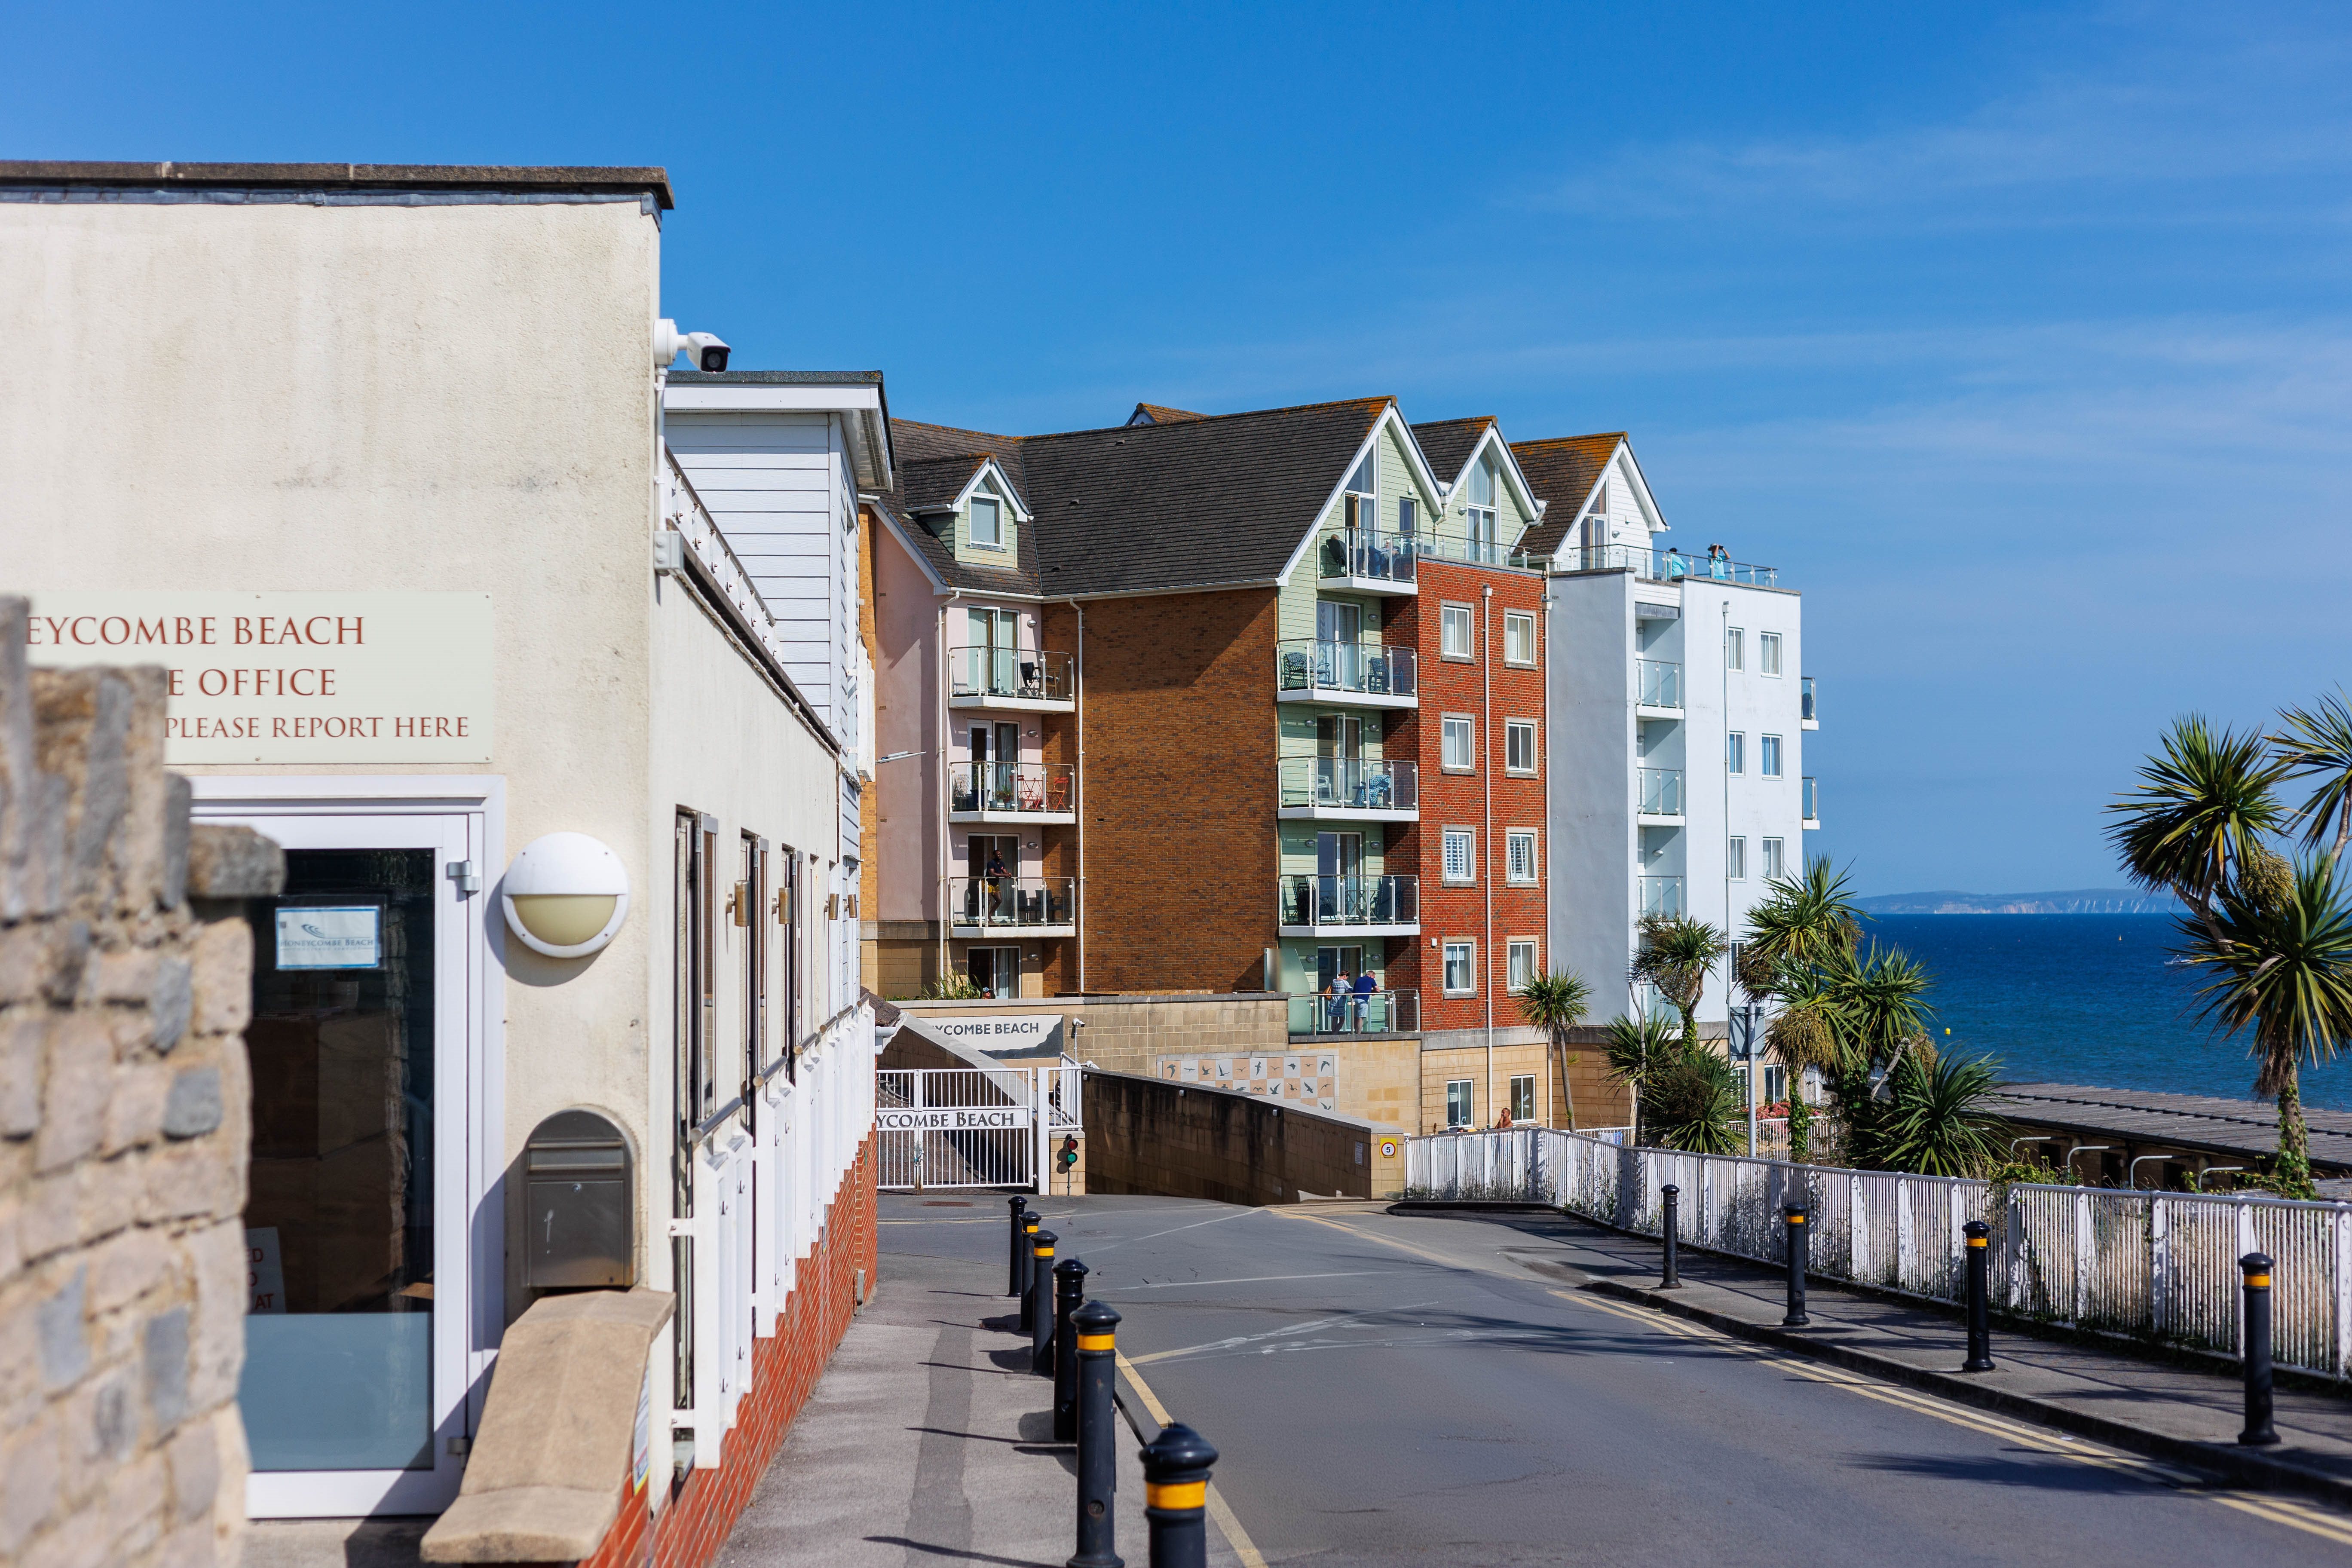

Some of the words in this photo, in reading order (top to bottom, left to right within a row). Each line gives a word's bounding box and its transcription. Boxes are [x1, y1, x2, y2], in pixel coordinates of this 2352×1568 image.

[27, 616, 217, 644] EYCOMBE
[233, 616, 365, 644] BEACH
[198, 668, 336, 696] OFFICE
[164, 717, 260, 738] PLEASE
[272, 717, 384, 738] REPORT
[394, 717, 469, 737] HERE
[995, 1023, 1039, 1034] BEACH
[876, 1114, 949, 1128] YCOMBE
[955, 1112, 1014, 1127] BEACH
[255, 1294, 274, 1310] AT
